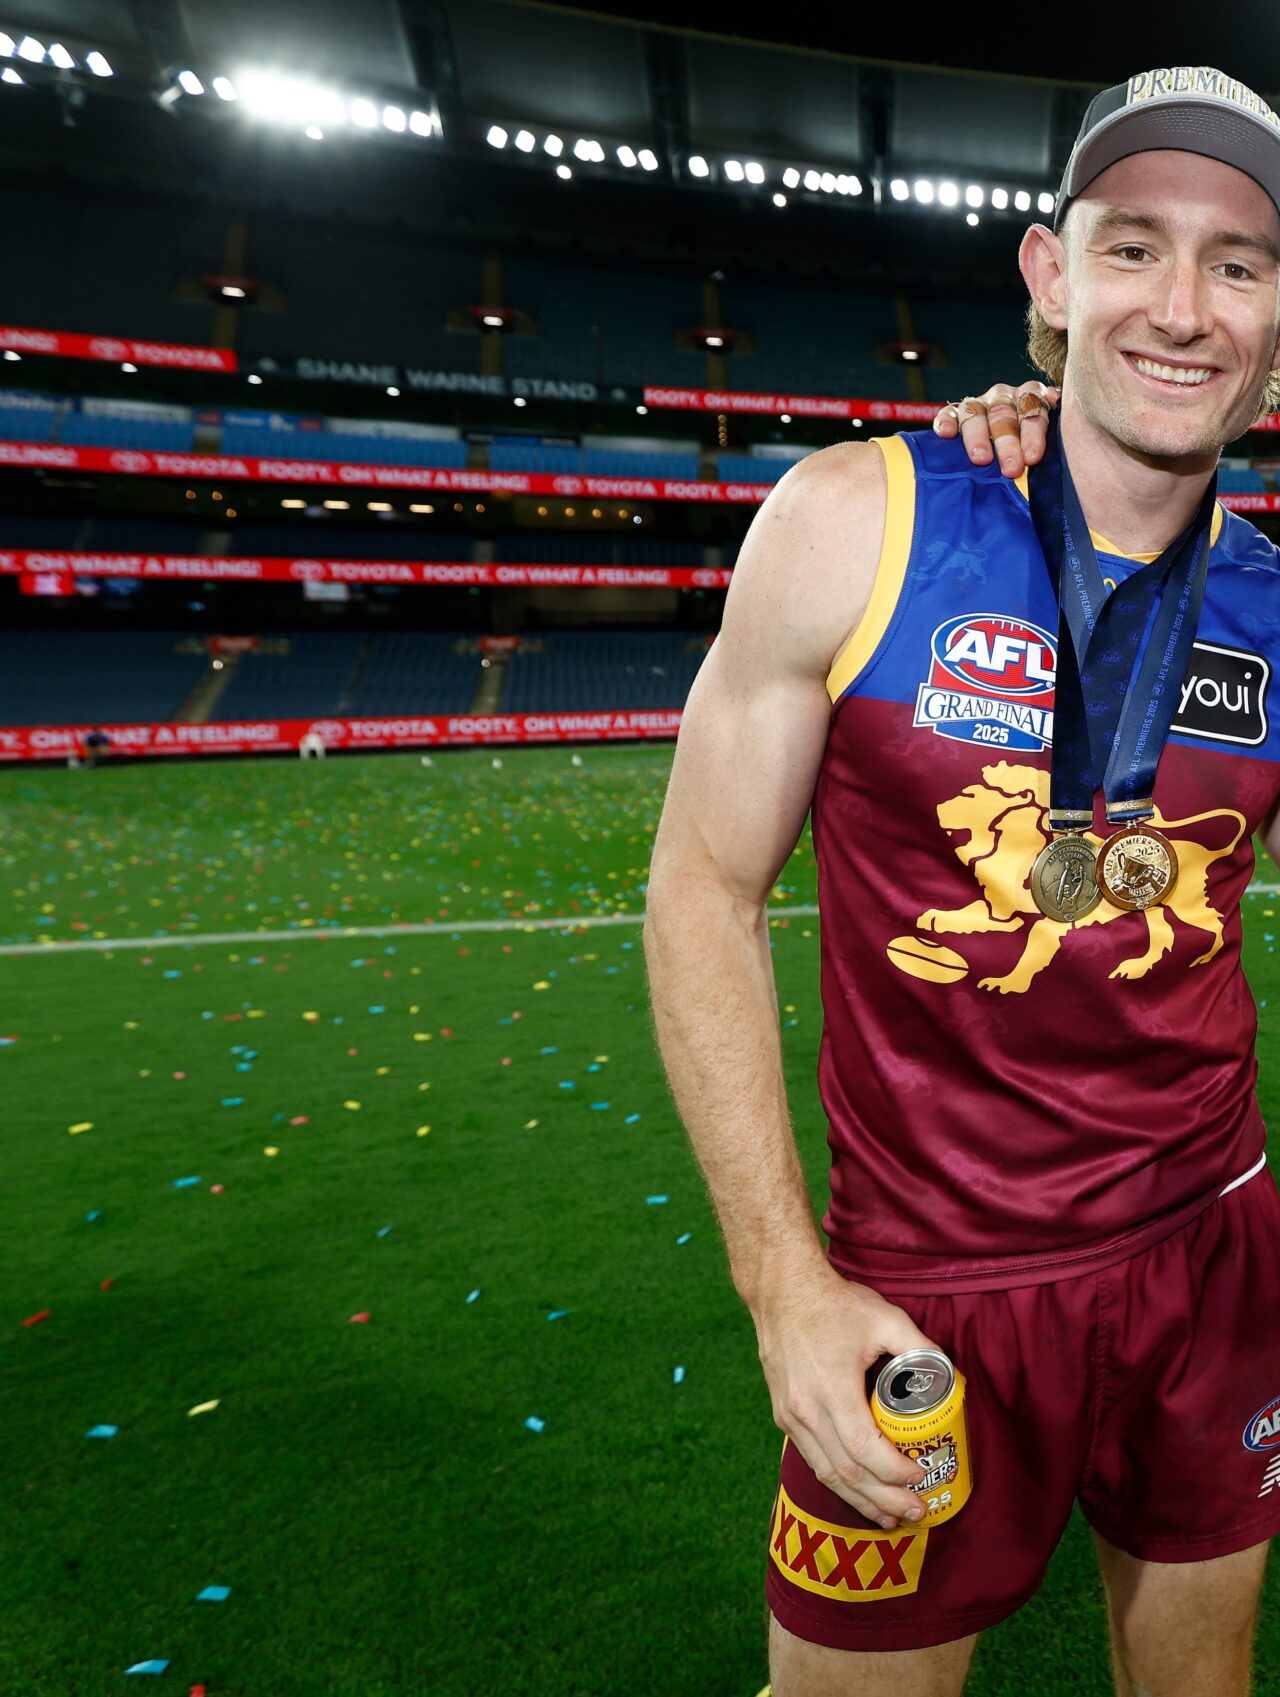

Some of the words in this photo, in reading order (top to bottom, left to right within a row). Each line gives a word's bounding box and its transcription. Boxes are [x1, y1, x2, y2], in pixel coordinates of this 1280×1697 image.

[132, 341, 222, 367] TOYOTA
[298, 358, 398, 384] SHANE
[405, 368, 504, 394] WARNE
[513, 378, 597, 400] STAND
[153, 453, 249, 476] TOYOTA
[586, 478, 656, 495] TOYOTA
[1064, 532, 1074, 551] 2025
[328, 562, 413, 580] TOYOTA
[1184, 585, 1192, 597] AFL
[1074, 574, 1084, 589] AFL
[1079, 590, 1096, 630] PREMIERS
[1174, 614, 1184, 630] 2025
[944, 628, 1056, 682] AFL
[1163, 631, 1179, 666] PREMIERS
[1158, 666, 1169, 680] AFL
[1177, 672, 1250, 714] youi
[924, 692, 994, 720] GRAND
[1150, 700, 1159, 718] 2025
[348, 719, 437, 738] TOYOTA
[972, 724, 1009, 744] 2025
[1134, 718, 1152, 756] PREMIERS
[1130, 758, 1140, 772] AFL
[1111, 838, 1152, 857] PREMIERS
[1136, 845, 1160, 858] 2025
[880, 1418, 900, 1432] OFFICIAL
[929, 1418, 938, 1426] THE
[940, 1406, 954, 1420] LIONS
[896, 1434, 940, 1448] BRISBANE
[896, 1430, 954, 1460] IONS
[928, 1490, 952, 1510] 25
[774, 1499, 917, 1591] XXXX
